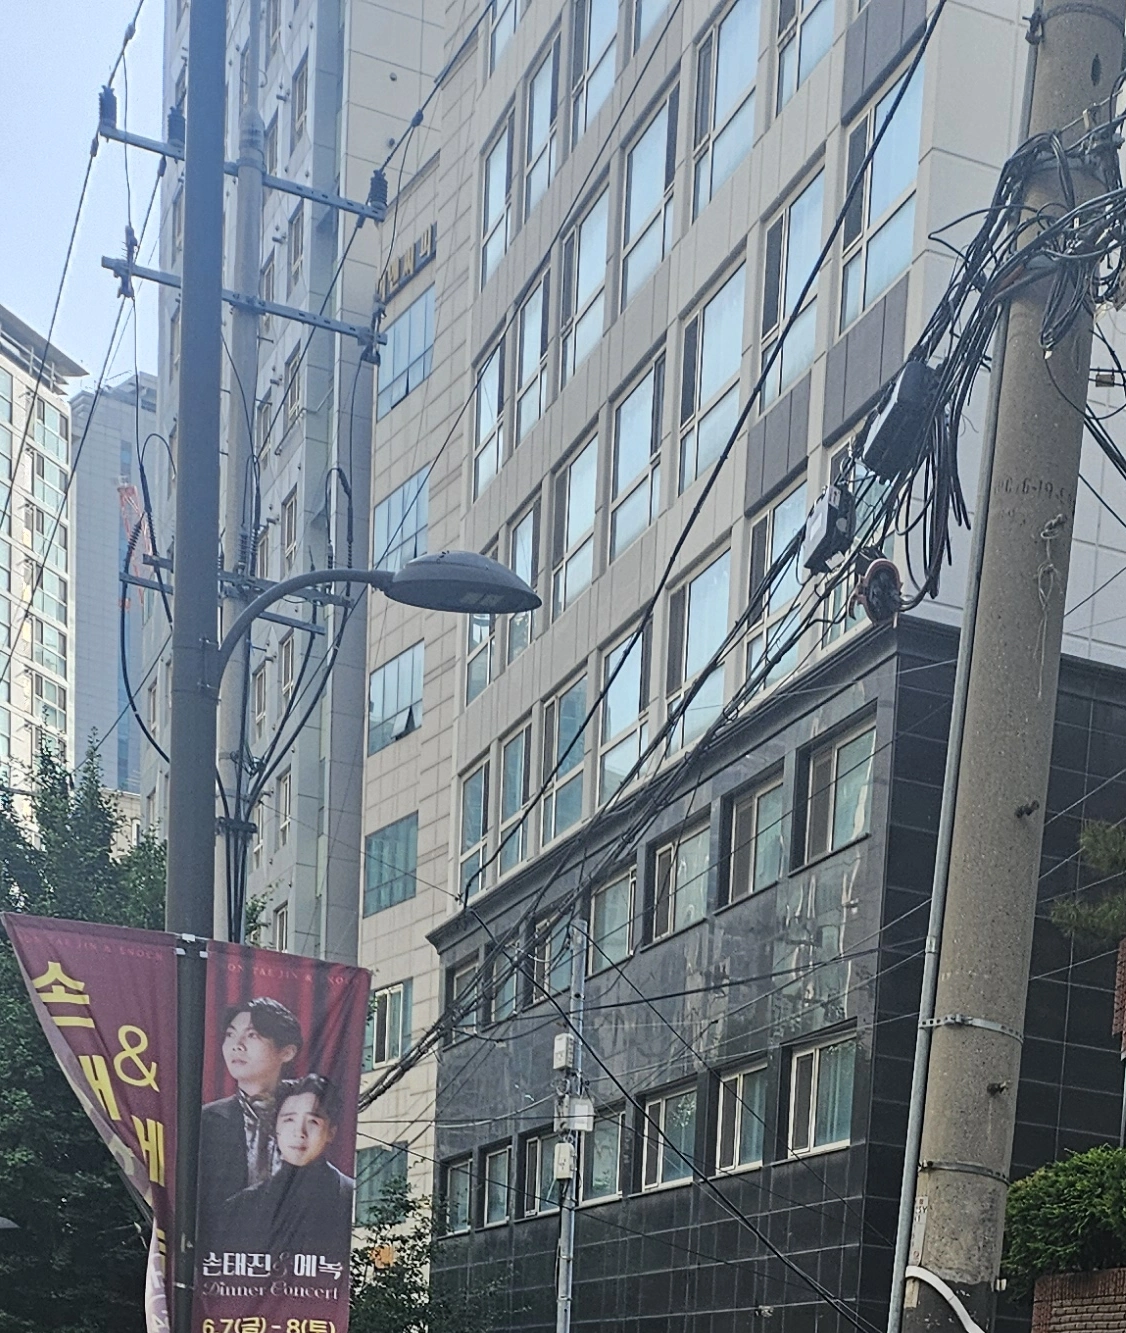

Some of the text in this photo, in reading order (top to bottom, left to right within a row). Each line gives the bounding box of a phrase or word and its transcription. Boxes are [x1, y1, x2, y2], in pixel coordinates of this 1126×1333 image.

[113, 1025, 159, 1093] &
[202, 1252, 272, 1277] 손태진
[293, 1253, 344, 1280] 에녹
[202, 1281, 339, 1300] Dinner Concert
